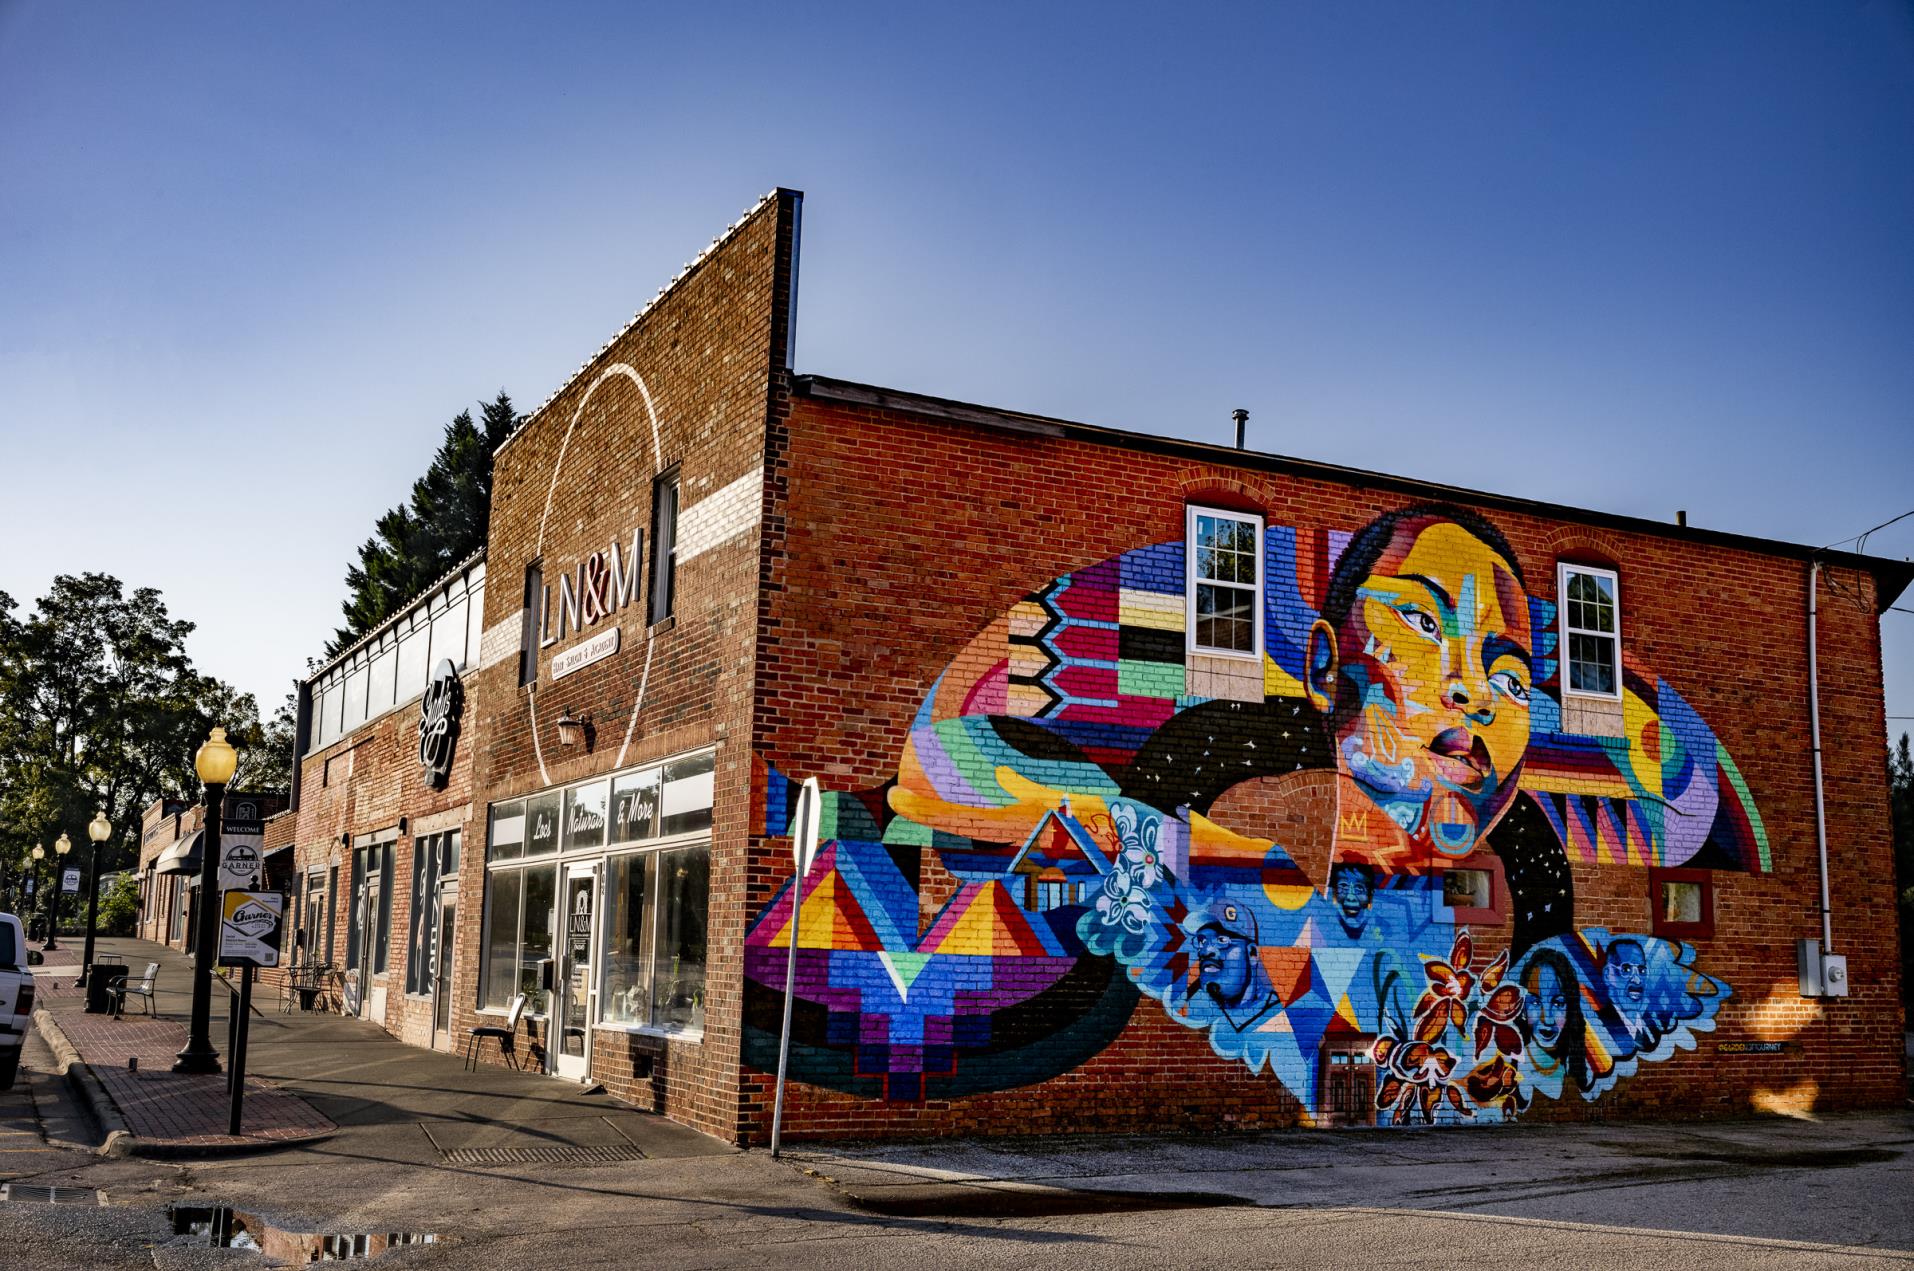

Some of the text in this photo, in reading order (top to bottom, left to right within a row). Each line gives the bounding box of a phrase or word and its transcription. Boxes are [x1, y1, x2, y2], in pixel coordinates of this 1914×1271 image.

[540, 528, 643, 648] LN&M
[533, 813, 552, 840] Locs
[617, 800, 625, 825] &
[626, 791, 654, 823] More
[233, 910, 272, 923] Garner
[1225, 906, 1237, 921] G
